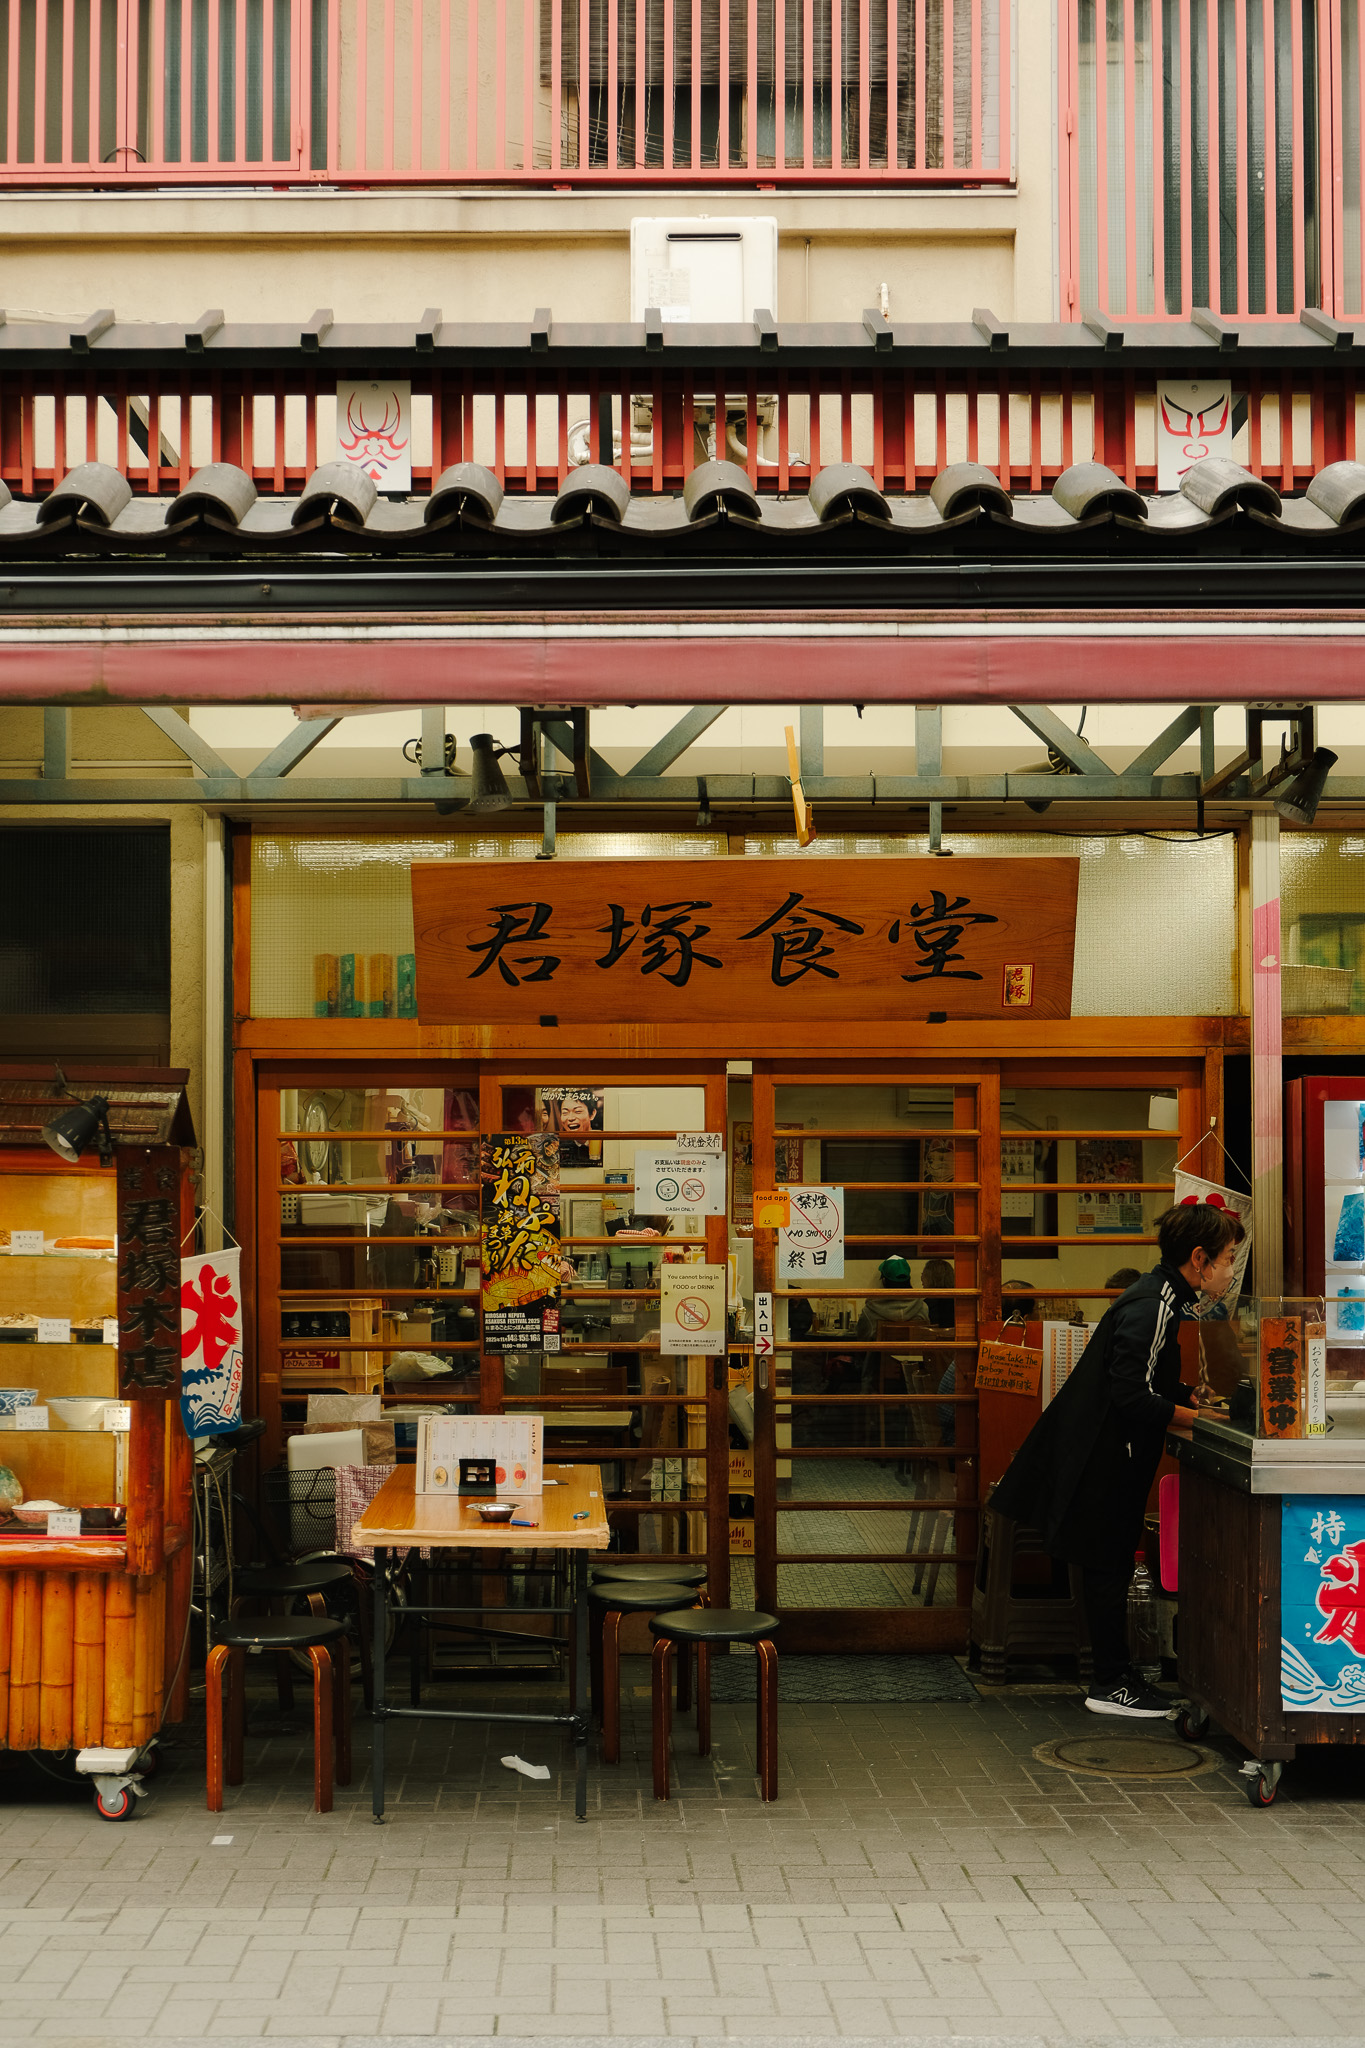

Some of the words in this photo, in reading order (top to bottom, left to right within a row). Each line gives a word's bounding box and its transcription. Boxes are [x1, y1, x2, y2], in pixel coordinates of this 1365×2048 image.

[466, 889, 998, 988] 君塚食堂
[1010, 967, 1026, 999] 君塚
[491, 1147, 536, 1175] 弘前
[788, 1229, 803, 1238] NO
[787, 1250, 828, 1269] 終日
[758, 1296, 768, 1332] 出入口
[1283, 1321, 1298, 1345] 只今
[981, 1346, 1005, 1360] Please
[1006, 1351, 1024, 1364] take
[1025, 1354, 1038, 1366] the
[1311, 1346, 1322, 1378] おでん
[1267, 1346, 1299, 1431] 営業中
[1308, 1423, 1326, 1434] 150
[743, 1469, 752, 1477] 20
[1310, 1510, 1346, 1546] 特
[743, 1540, 752, 1548] 20
